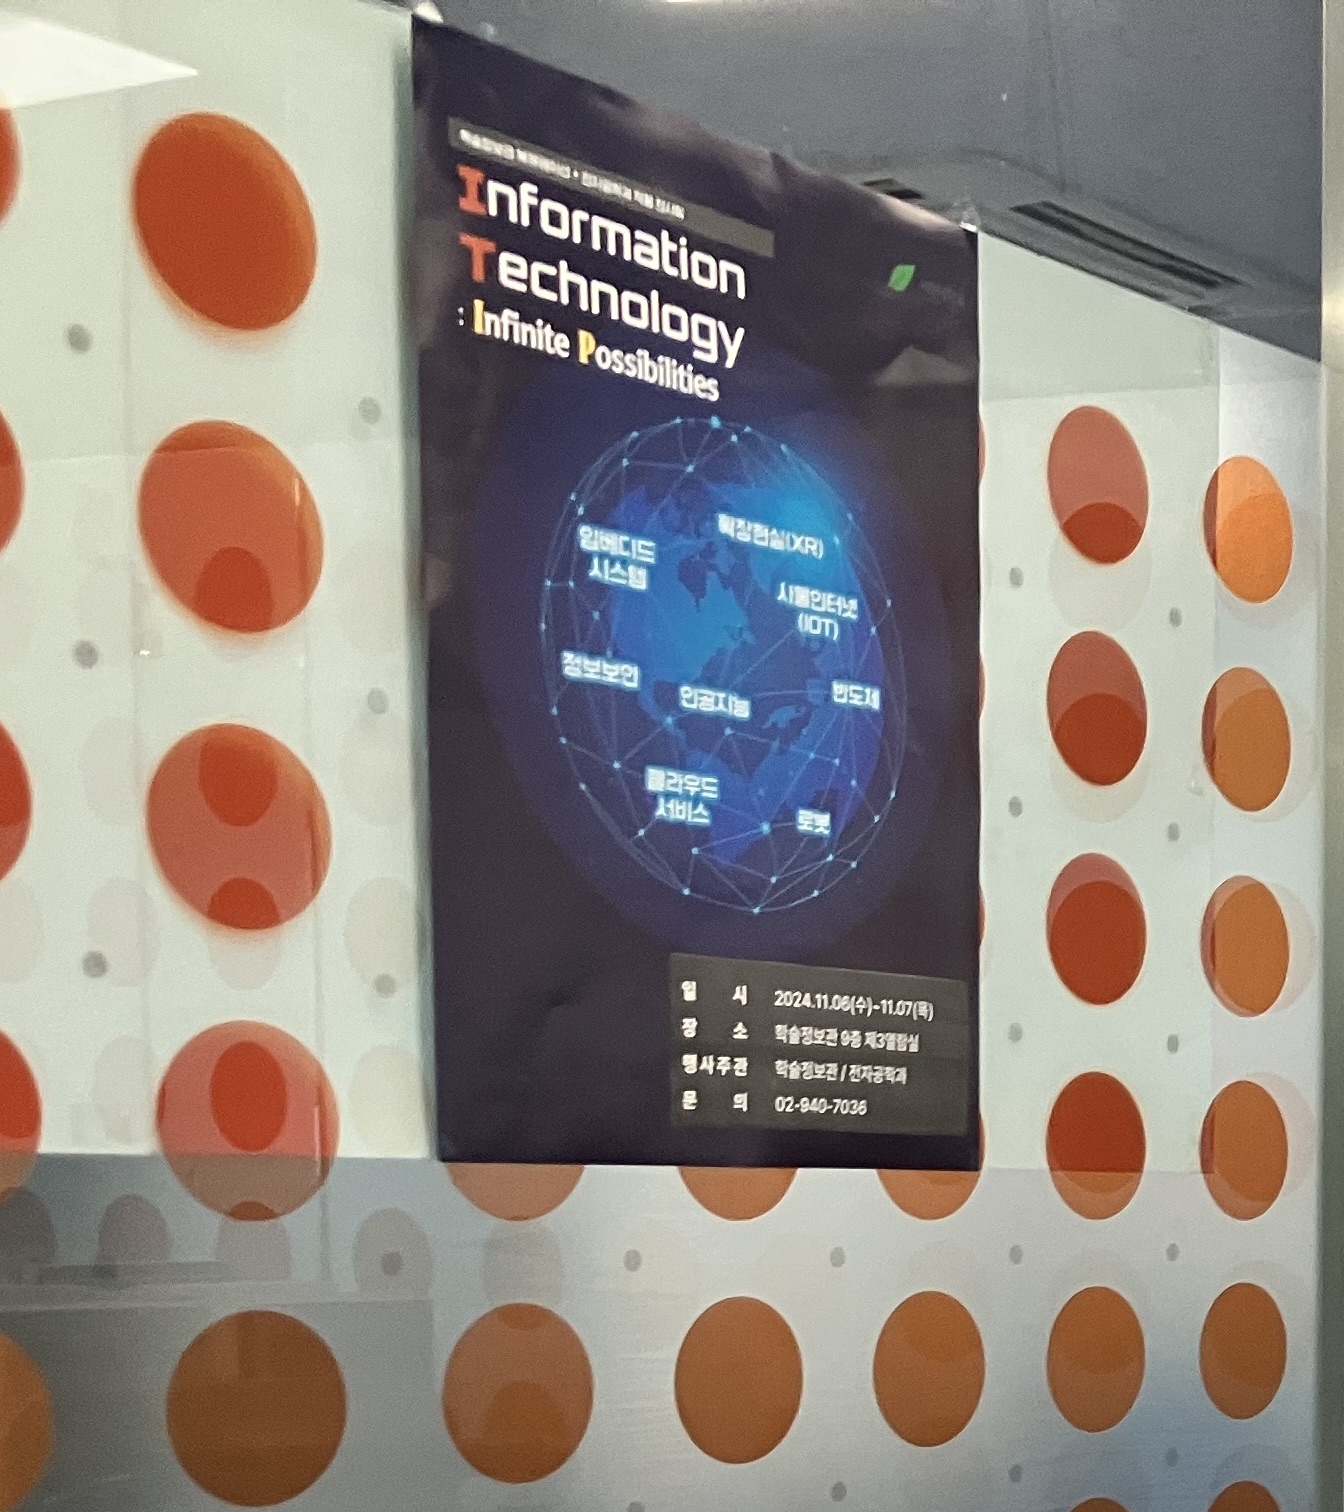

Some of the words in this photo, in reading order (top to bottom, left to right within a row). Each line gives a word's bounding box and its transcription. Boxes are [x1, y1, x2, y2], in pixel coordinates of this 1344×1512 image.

[456, 164, 747, 300] Information
[458, 233, 747, 369] Technology
[473, 299, 570, 358] Infinite
[577, 332, 721, 402] Possibilities
[577, 523, 657, 565] 임베디드
[716, 512, 824, 559] 확장현실(XR)
[587, 555, 650, 591] 시스템
[776, 581, 859, 621] 사물인터넷
[560, 650, 641, 691] 정보보안
[678, 685, 753, 720] 인공지능
[830, 679, 882, 712] 반도체
[645, 765, 720, 799] 클라우드
[655, 796, 712, 826] 서비스
[797, 809, 831, 837] 로봇
[681, 1053, 748, 1077] 행사주관
